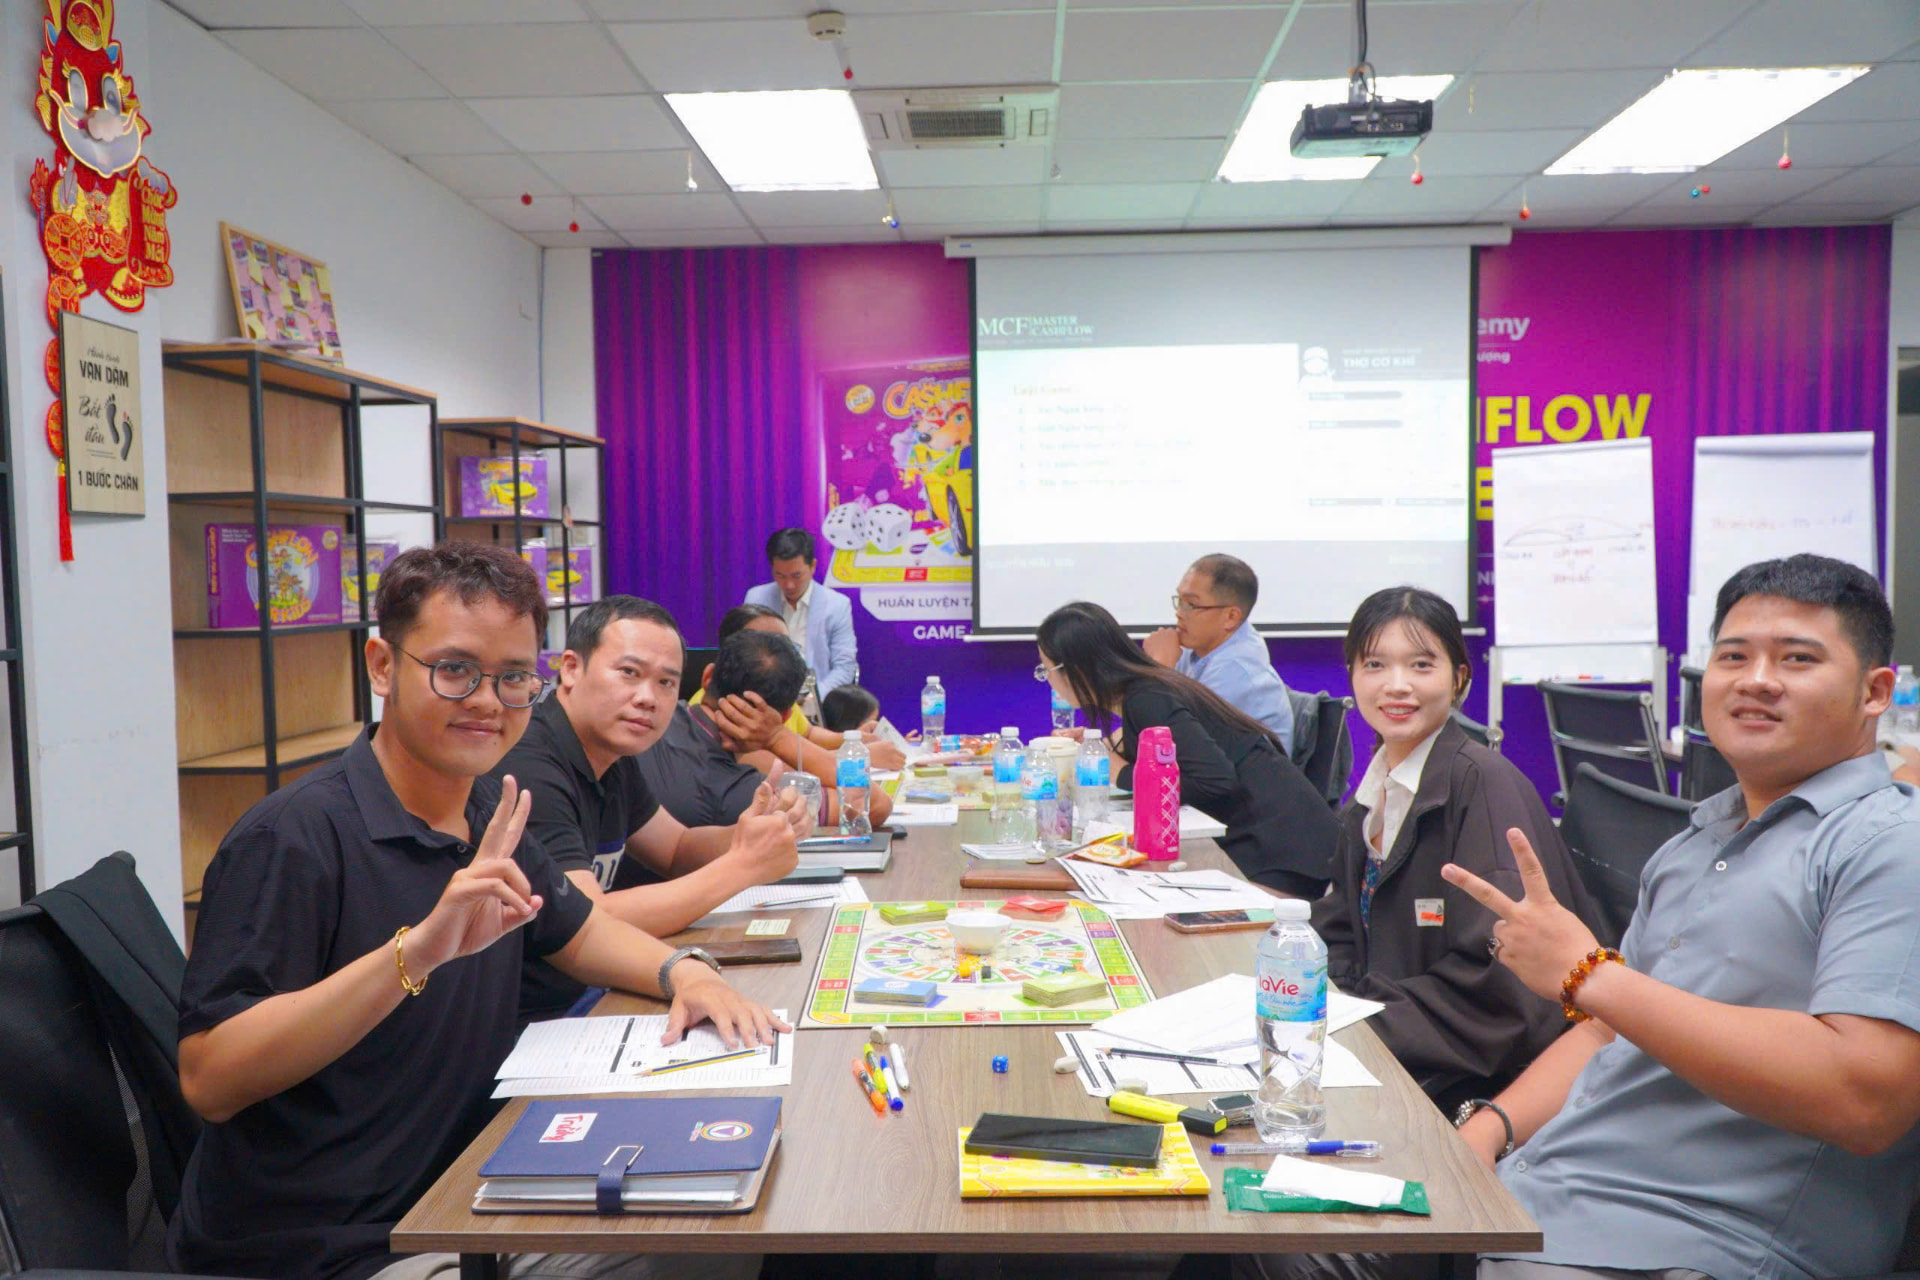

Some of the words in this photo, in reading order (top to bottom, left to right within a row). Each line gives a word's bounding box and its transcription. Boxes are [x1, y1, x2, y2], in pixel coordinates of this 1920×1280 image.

[978, 317, 1027, 336] MCF
[1031, 315, 1078, 325] MASTER
[1031, 325, 1094, 336] CASHFLOW
[1476, 394, 1652, 443] FLOW
[78, 470, 83, 486] 1
[878, 594, 915, 609] HUẤN
[918, 593, 960, 608] LUYỆN
[913, 625, 966, 640] GAME
